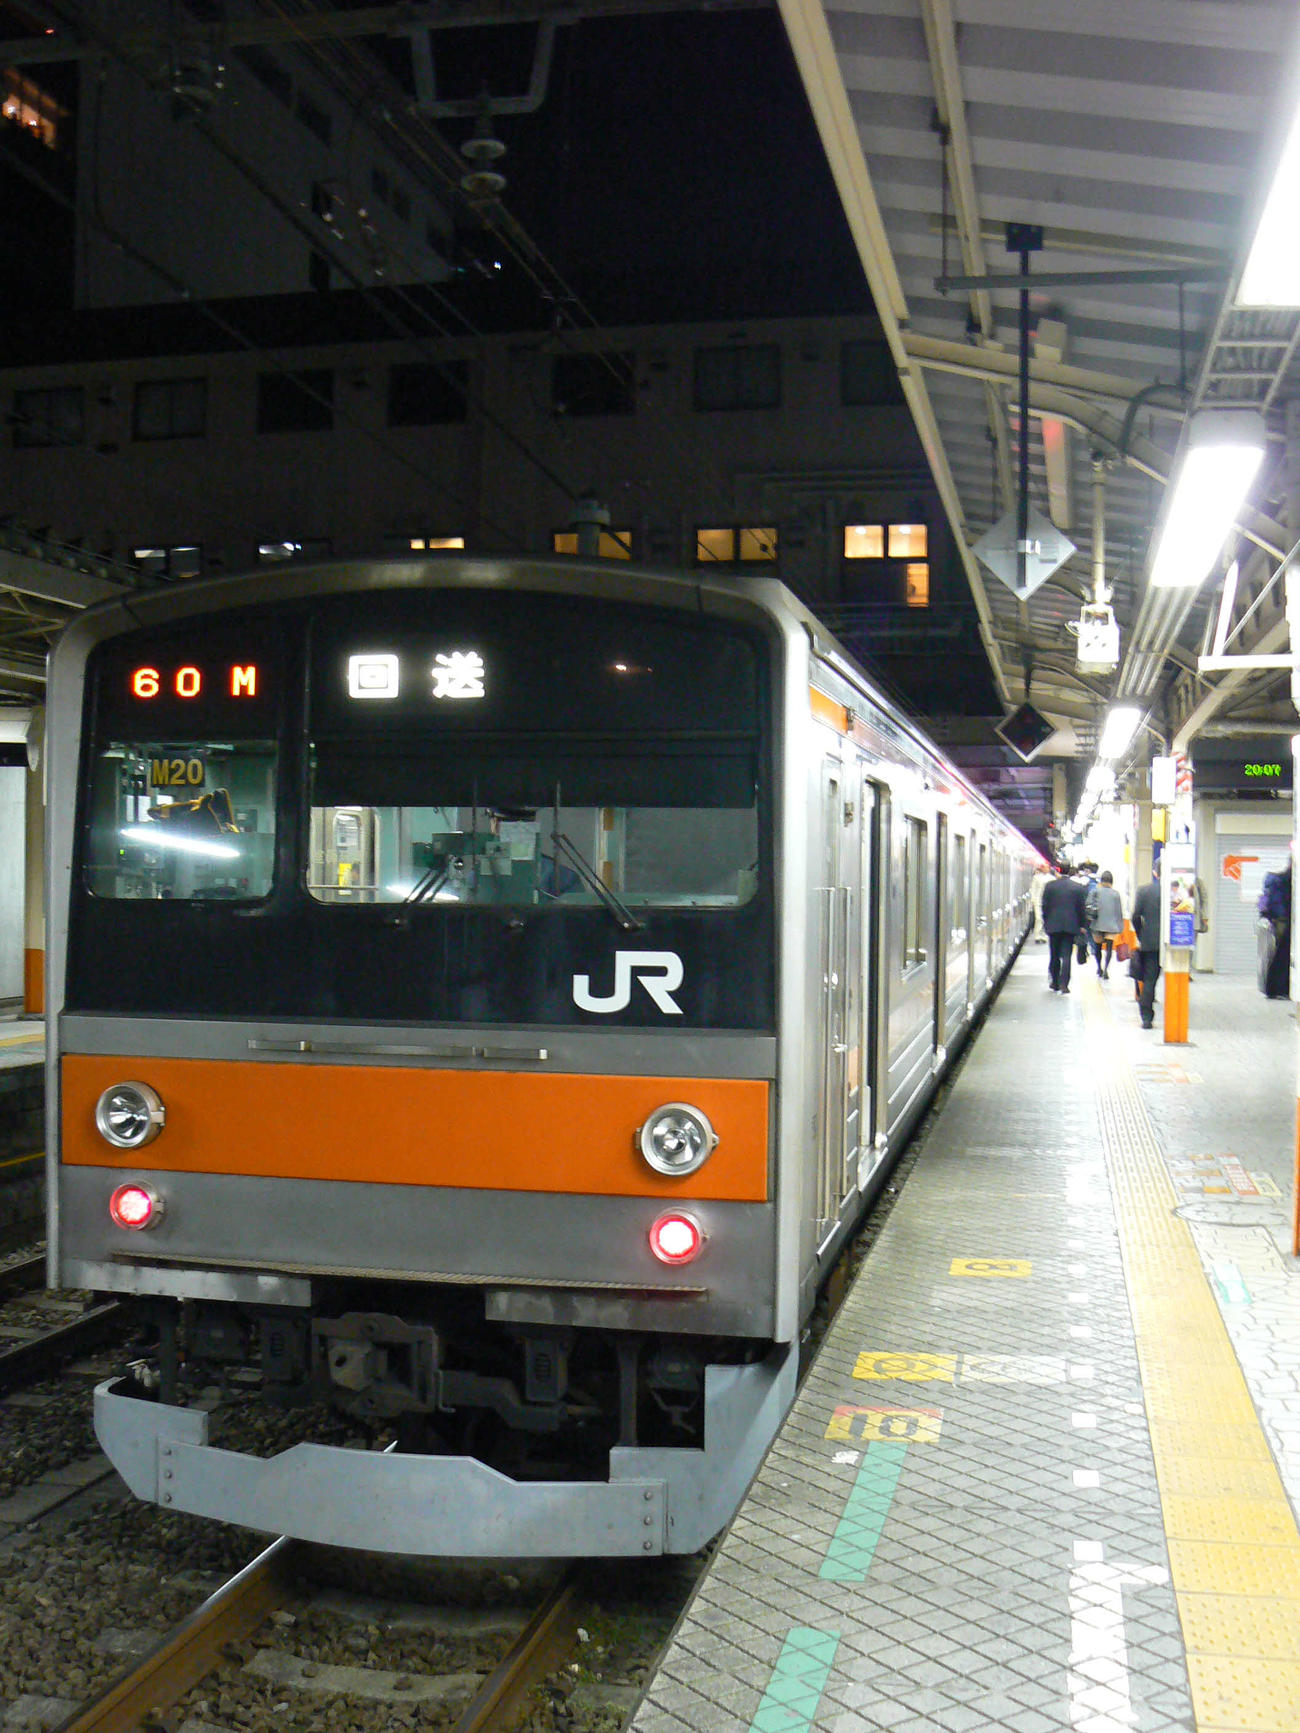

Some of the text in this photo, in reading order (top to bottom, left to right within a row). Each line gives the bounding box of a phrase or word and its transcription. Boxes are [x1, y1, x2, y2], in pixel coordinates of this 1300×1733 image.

[133, 665, 257, 697] 60 M
[349, 651, 485, 699] 回送
[152, 759, 203, 785] M20
[572, 951, 684, 1014] JR
[848, 1412, 919, 1440] 10
